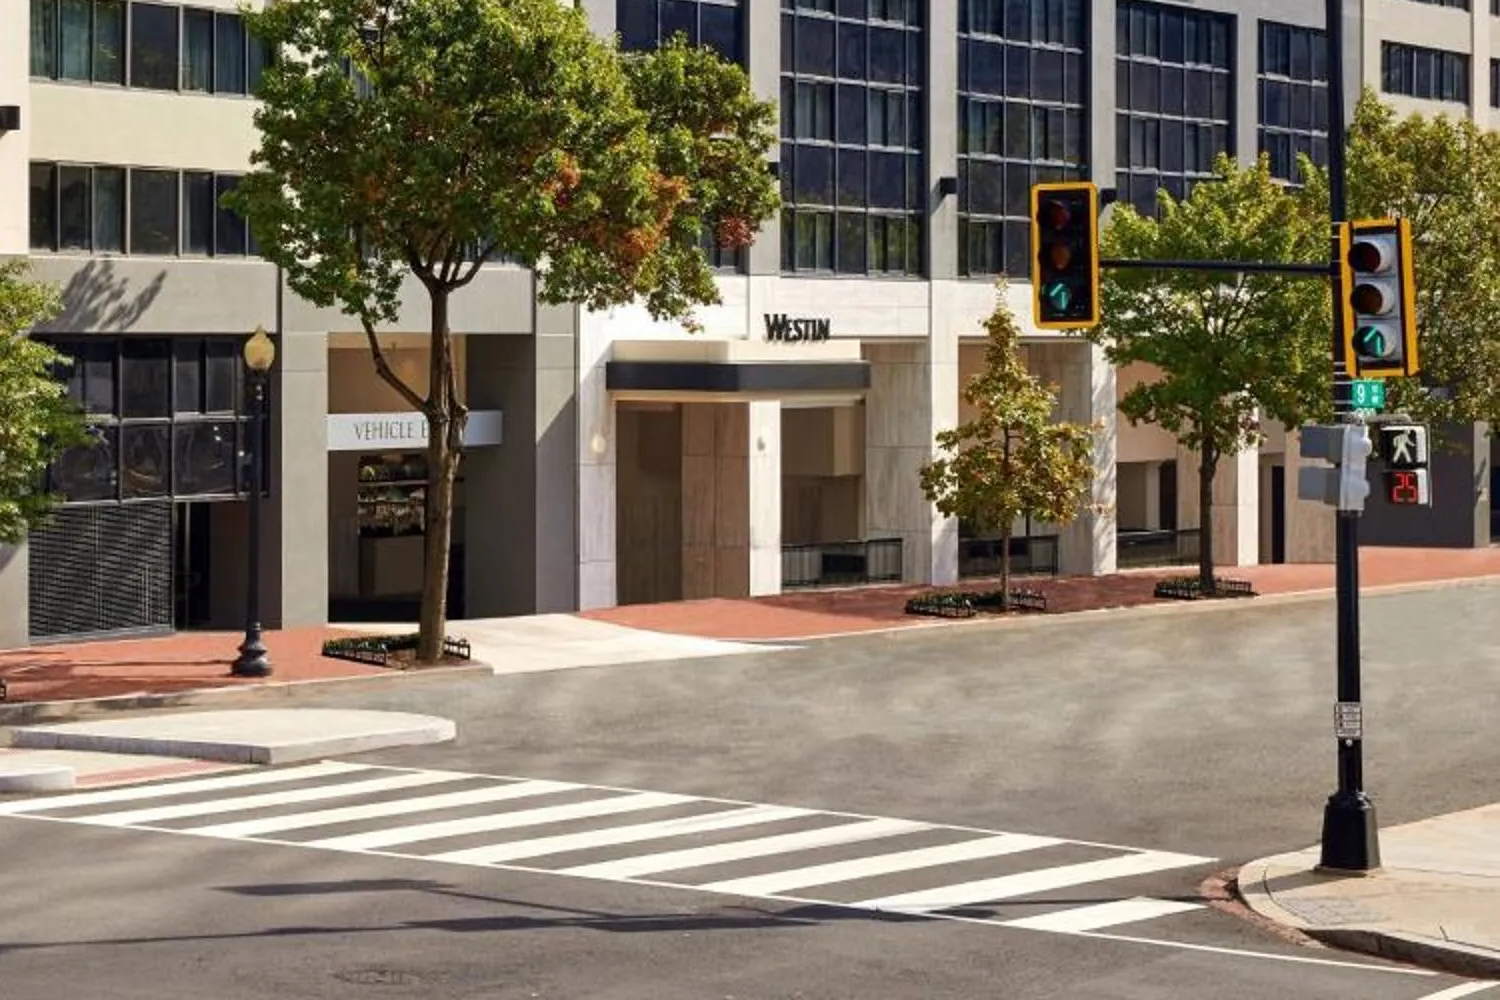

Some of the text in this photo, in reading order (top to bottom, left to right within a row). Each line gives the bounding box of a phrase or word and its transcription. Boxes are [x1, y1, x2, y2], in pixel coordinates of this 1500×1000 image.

[763, 313, 830, 341] WESTIN
[1357, 383, 1365, 404] 9
[354, 420, 414, 441] VEHICLE
[1393, 473, 1417, 503] 25
